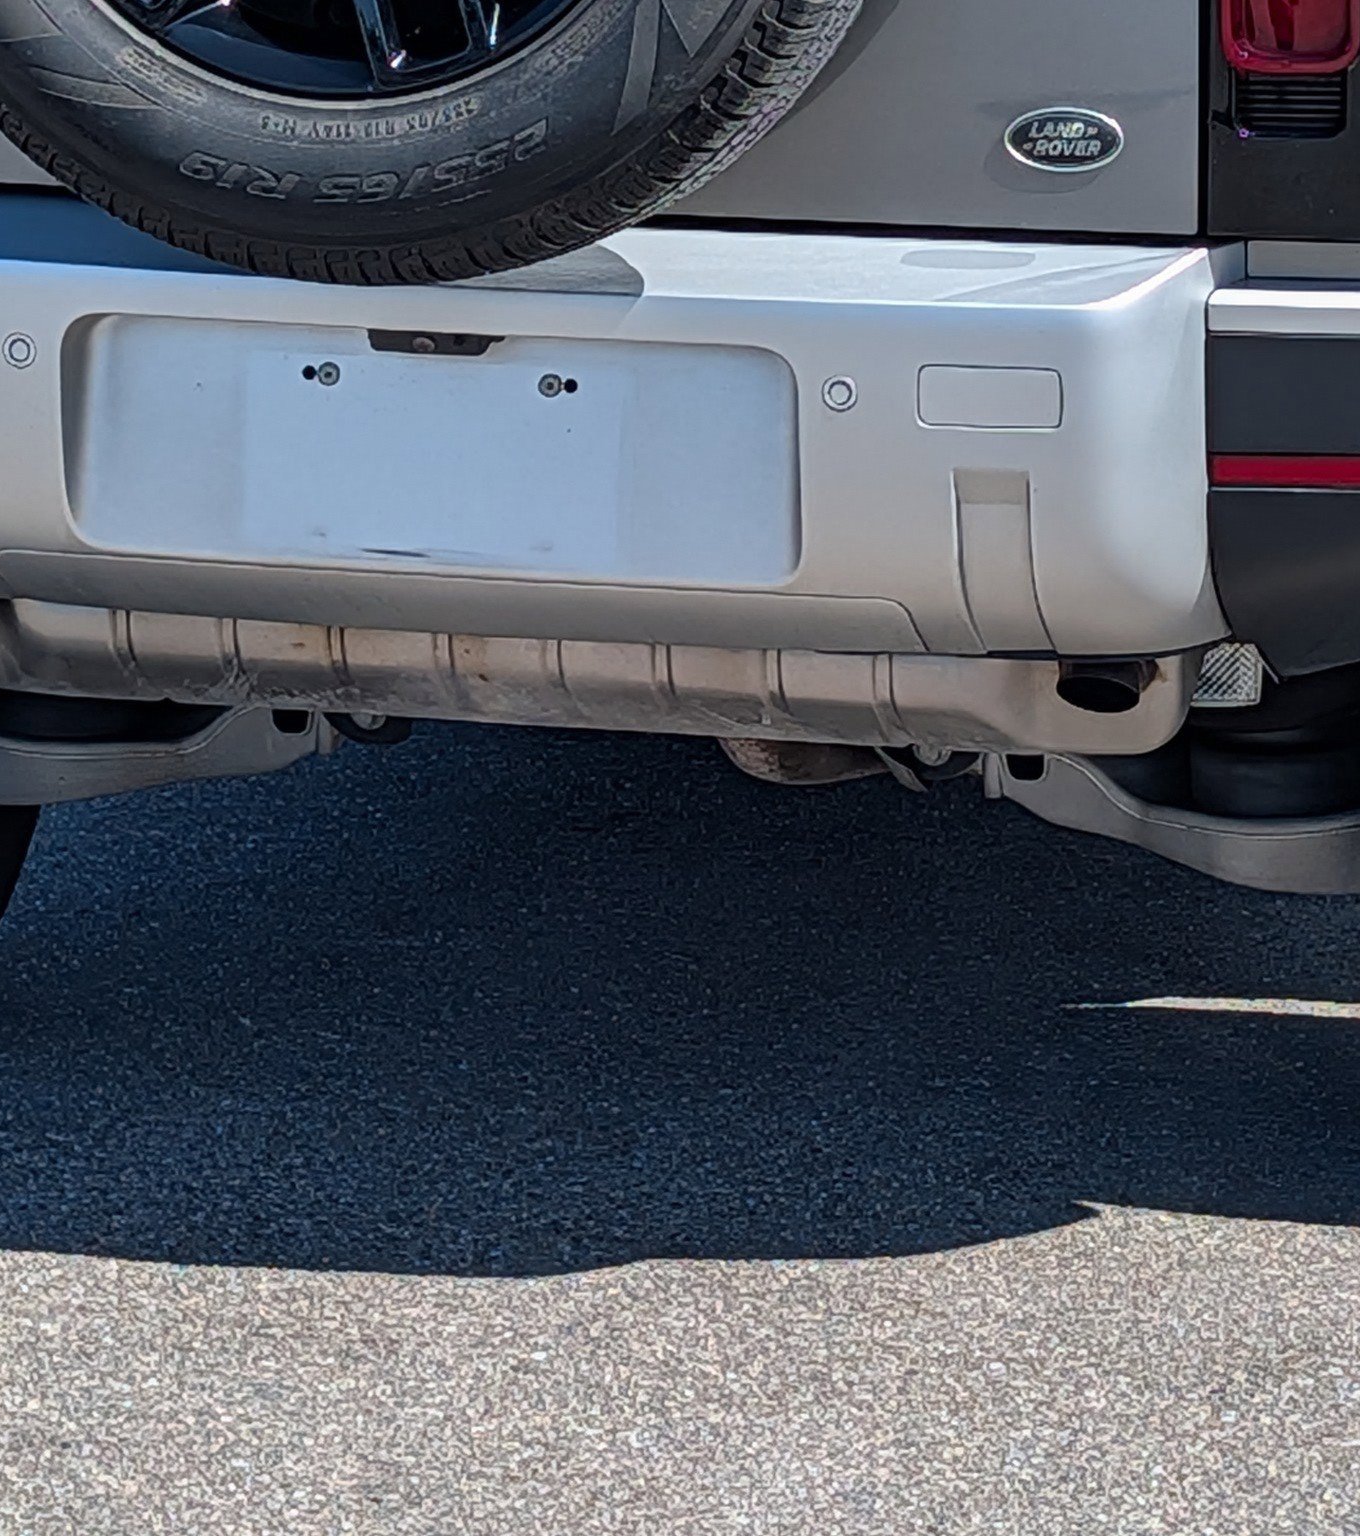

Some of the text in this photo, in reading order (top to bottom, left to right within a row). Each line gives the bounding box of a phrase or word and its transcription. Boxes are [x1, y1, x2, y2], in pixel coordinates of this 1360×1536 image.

[1028, 121, 1085, 139] LAND
[312, 117, 549, 204] 255/65
[1033, 139, 1102, 156] ROVER
[177, 150, 302, 200] R19
